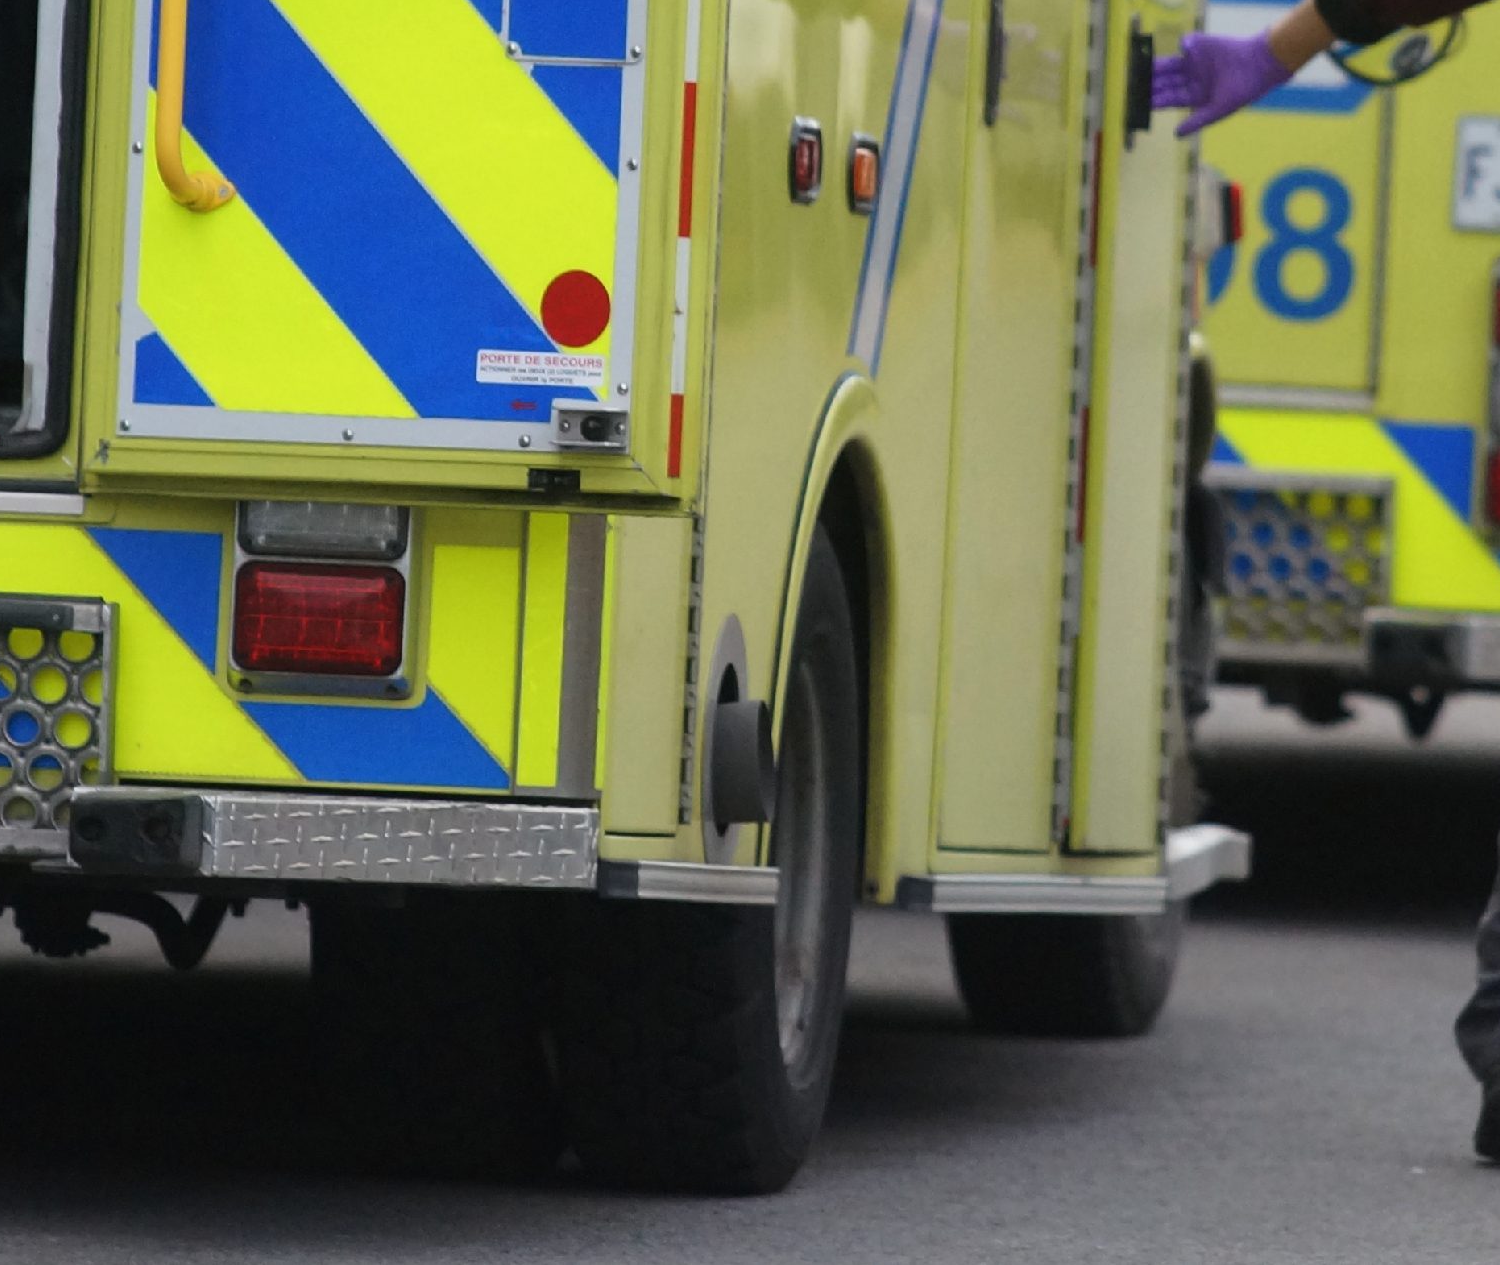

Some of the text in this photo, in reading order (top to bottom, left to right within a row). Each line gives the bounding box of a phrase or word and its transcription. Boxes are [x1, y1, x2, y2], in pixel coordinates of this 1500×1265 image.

[480, 353, 603, 368] PORTE DE SECOURS
